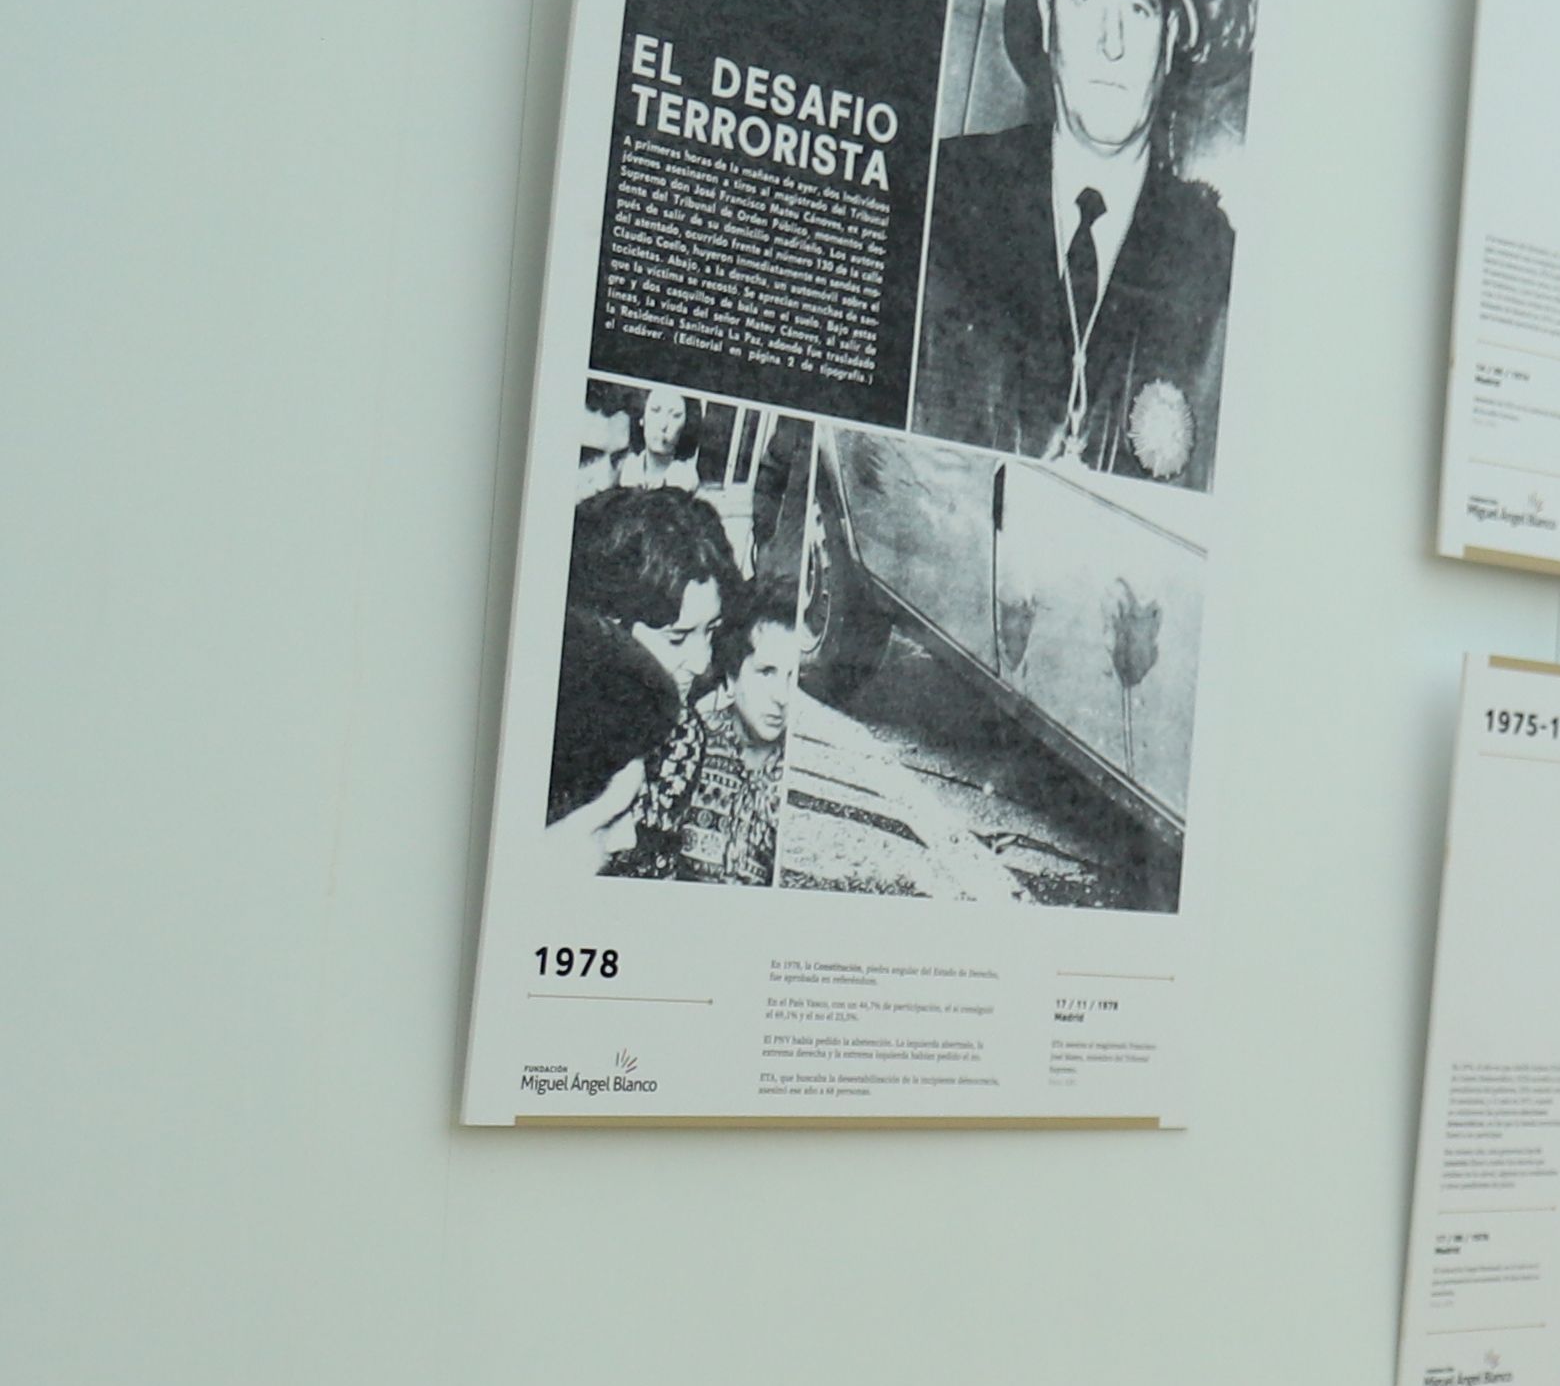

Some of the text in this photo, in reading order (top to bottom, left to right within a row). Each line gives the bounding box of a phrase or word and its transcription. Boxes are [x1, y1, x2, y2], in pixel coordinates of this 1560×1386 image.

[632, 34, 897, 142] EL DESAFIO
[631, 83, 888, 190] TERRORISTA
[623, 135, 631, 145] A
[634, 140, 680, 159] primeras
[684, 149, 711, 166] horas
[714, 158, 726, 170] de
[729, 162, 738, 173] la
[782, 176, 794, 188] de
[822, 186, 839, 199] dos
[665, 164, 718, 183] asesinaron
[722, 178, 728, 186] a
[733, 179, 756, 193] tiros
[760, 186, 770, 196] al
[831, 203, 846, 215] del
[851, 207, 888, 226] Tribunal
[618, 180, 646, 197] dente
[651, 188, 668, 201] del
[673, 193, 716, 213] Tribunal
[720, 205, 732, 217] de
[736, 209, 767, 225] Orden
[620, 165, 666, 186] Supremo
[670, 178, 689, 192] don
[719, 189, 765, 210] Francisco
[769, 203, 799, 219] Mateu
[847, 225, 858, 233] ex
[613, 225, 652, 244] Claudio
[692, 243, 733, 263] huyeron
[736, 254, 813, 281] inmediatamente
[814, 275, 826, 285] en
[615, 210, 631, 223] del
[684, 229, 728, 247] ocurrido
[731, 237, 760, 254] frente
[763, 247, 772, 257] al
[816, 258, 833, 271] 130
[835, 264, 847, 275] de
[850, 267, 858, 277] la
[861, 271, 882, 283] calle
[645, 203, 658, 215] de
[663, 209, 685, 220] salir
[689, 213, 702, 225] de
[707, 220, 719, 229] su
[829, 247, 845, 260] Los
[850, 255, 884, 270] autores
[607, 274, 625, 284] gre
[630, 279, 636, 289] y
[642, 279, 660, 292] dos
[666, 287, 714, 305] casquillos
[720, 297, 732, 308] de
[737, 299, 758, 314] bala
[763, 309, 775, 317] en
[779, 311, 789, 321] el
[826, 320, 848, 335] Bajo
[852, 329, 876, 340] estas
[610, 259, 629, 270] que
[633, 261, 642, 273] la
[687, 276, 697, 285] se
[743, 286, 755, 298] Se
[758, 292, 799, 308] aprecian
[801, 302, 842, 318] manchas
[845, 310, 857, 321] de
[704, 265, 710, 273] a
[715, 264, 724, 276] la
[774, 281, 786, 290] un
[841, 296, 867, 309] sobre
[870, 301, 879, 312] el
[605, 318, 614, 328] el
[729, 346, 741, 355] en
[787, 356, 794, 366] 2
[800, 359, 813, 371] de
[606, 301, 615, 313] la
[620, 304, 674, 326] Residencia
[679, 317, 723, 337] Sanitaria
[728, 328, 739, 340] La
[806, 344, 822, 358] fue
[645, 295, 655, 306] la
[660, 299, 687, 314] viuda
[692, 306, 708, 317] del
[745, 317, 775, 333] Mateu
[826, 335, 835, 345] al
[839, 339, 860, 351] salir
[864, 343, 876, 355] de
[535, 946, 619, 978] 1978
[1054, 1013, 1085, 1022] Madrid
[520, 1073, 658, 1096] Miguel Ángel Blanco
[524, 1065, 568, 1073] FUNDACIÓN
